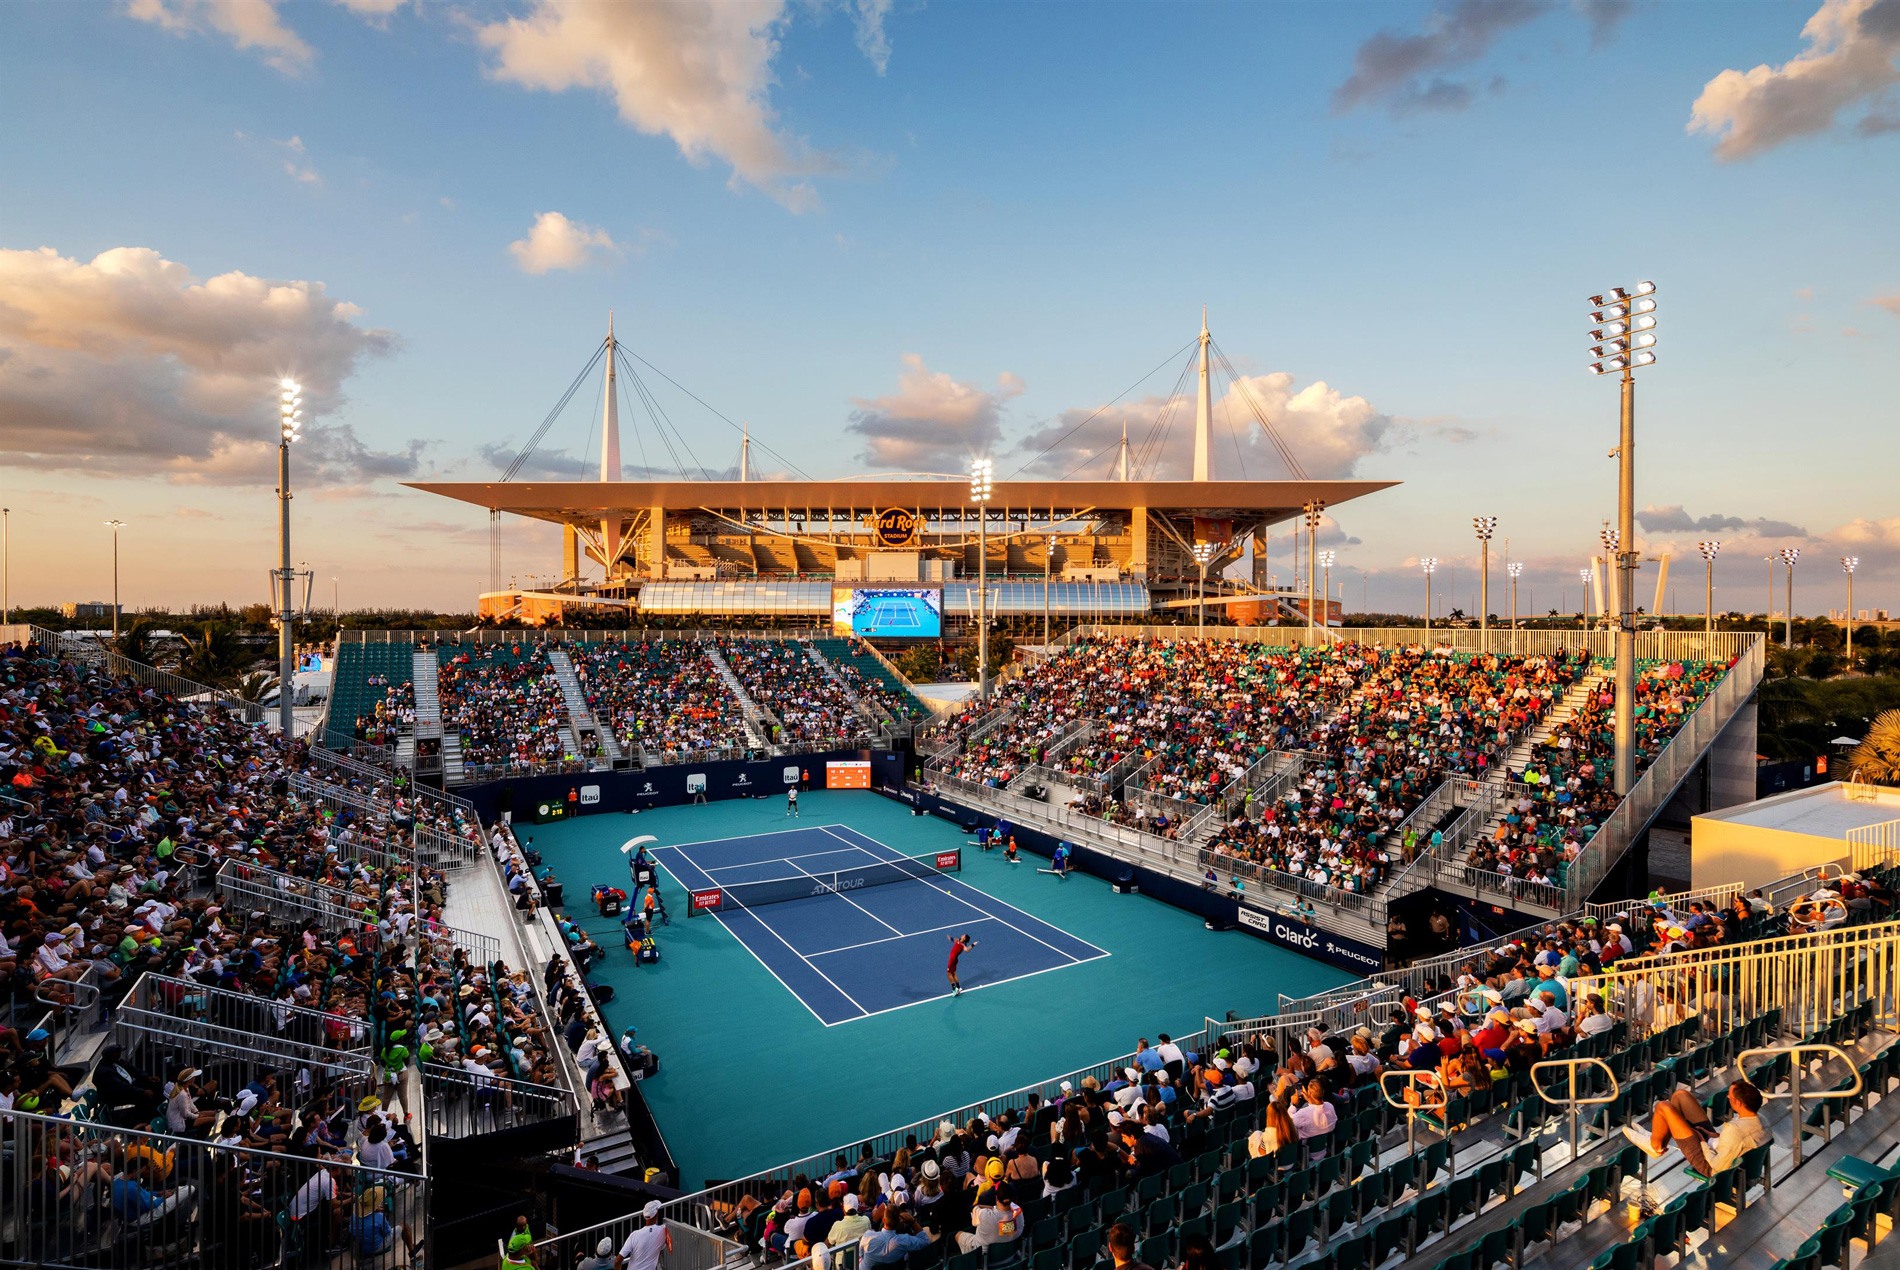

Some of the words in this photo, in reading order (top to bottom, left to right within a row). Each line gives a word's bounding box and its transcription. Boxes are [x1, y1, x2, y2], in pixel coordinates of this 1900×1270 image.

[863, 515, 895, 529] Hard
[896, 515, 928, 532] Rock
[784, 773, 798, 781] Itaú
[582, 794, 599, 802] Itaú
[837, 878, 865, 891] TOUR
[695, 894, 720, 902] Emirates
[1241, 910, 1266, 923] ASSIST
[1248, 918, 1267, 929] CARD
[1275, 924, 1313, 949] Claro
[1335, 946, 1380, 967] PEUGEOT
